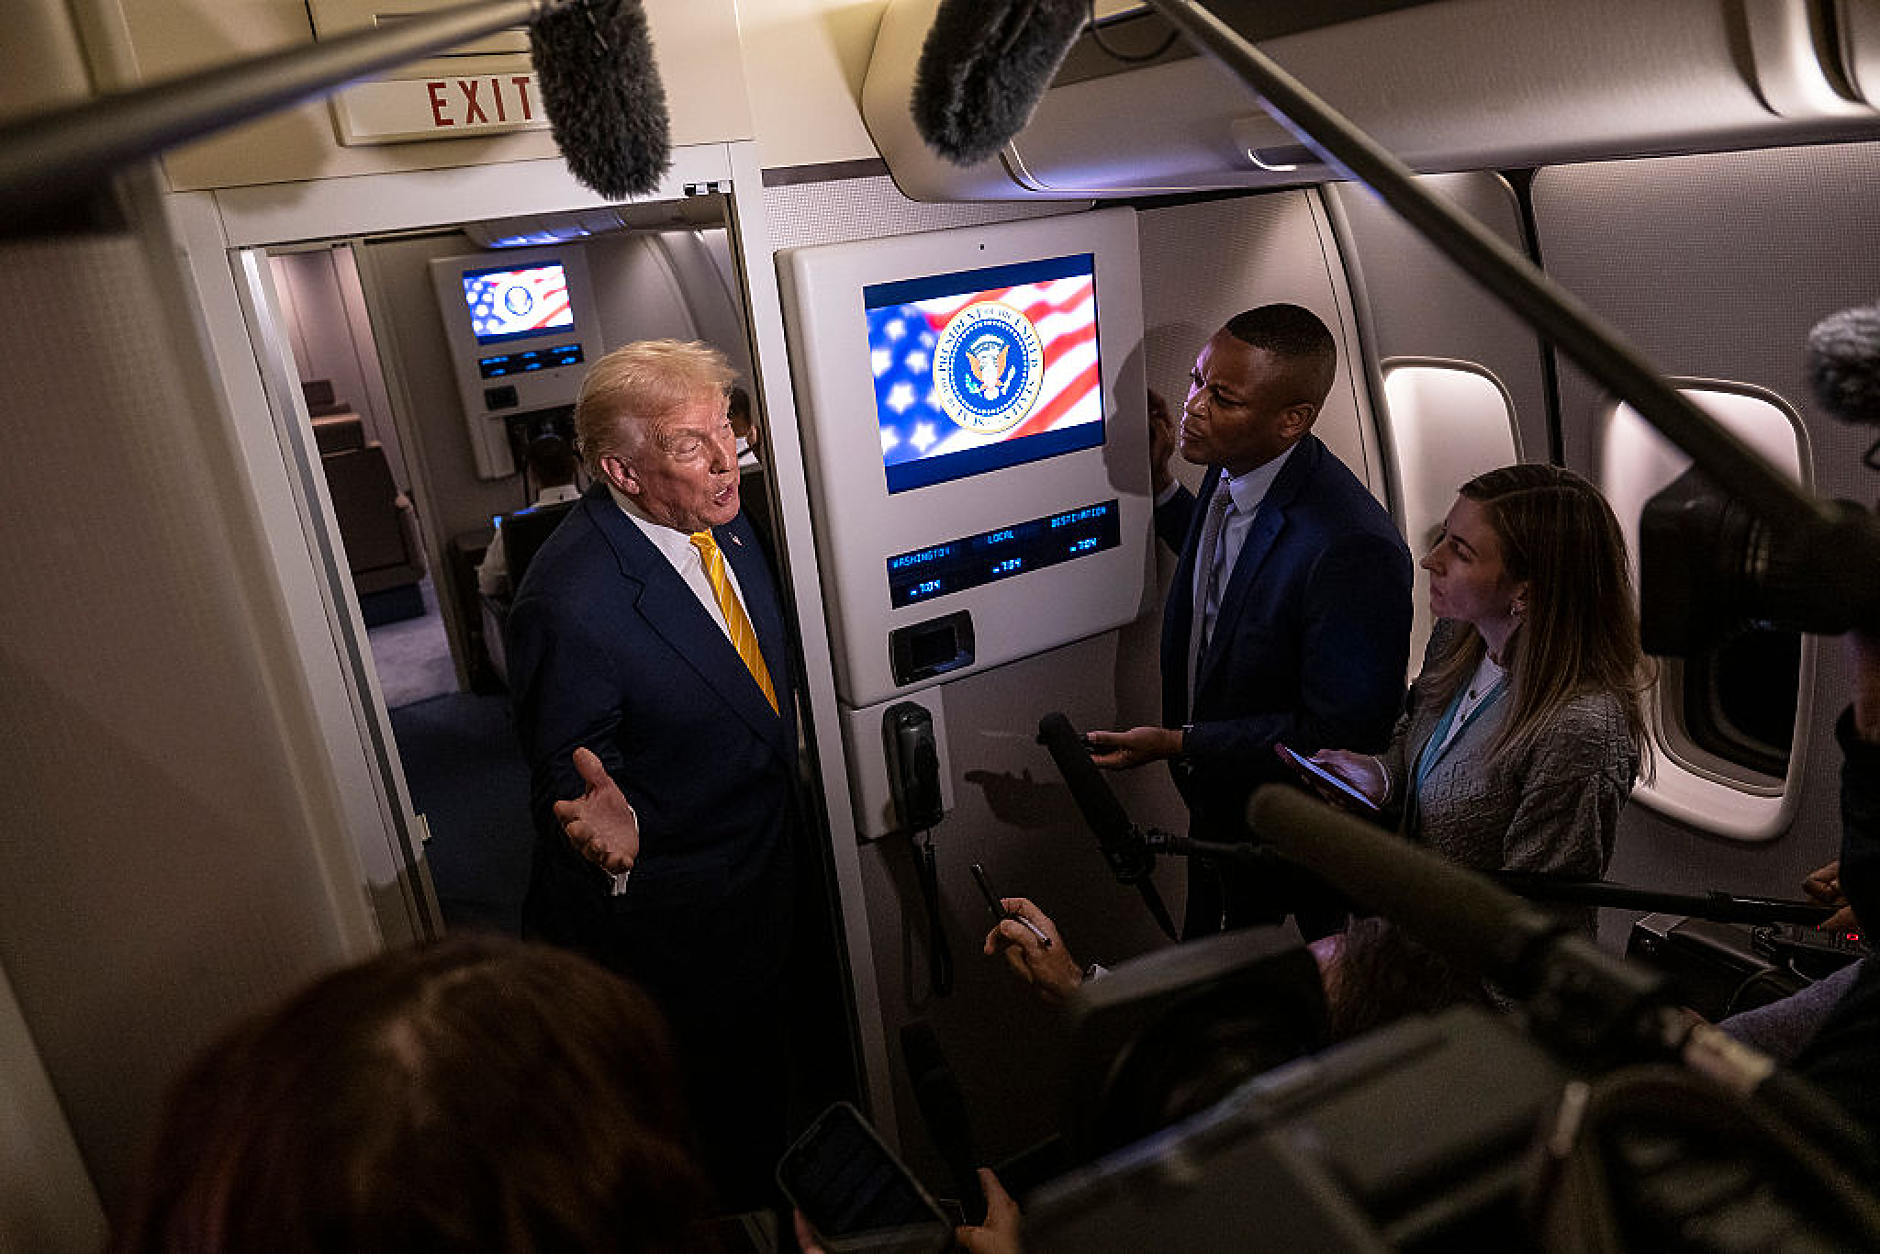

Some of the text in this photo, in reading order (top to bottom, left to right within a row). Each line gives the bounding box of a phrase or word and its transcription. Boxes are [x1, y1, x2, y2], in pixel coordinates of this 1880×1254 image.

[427, 77, 531, 127] EXIT
[987, 530, 1014, 544] LOCAL
[893, 547, 950, 568] WASHINGTON
